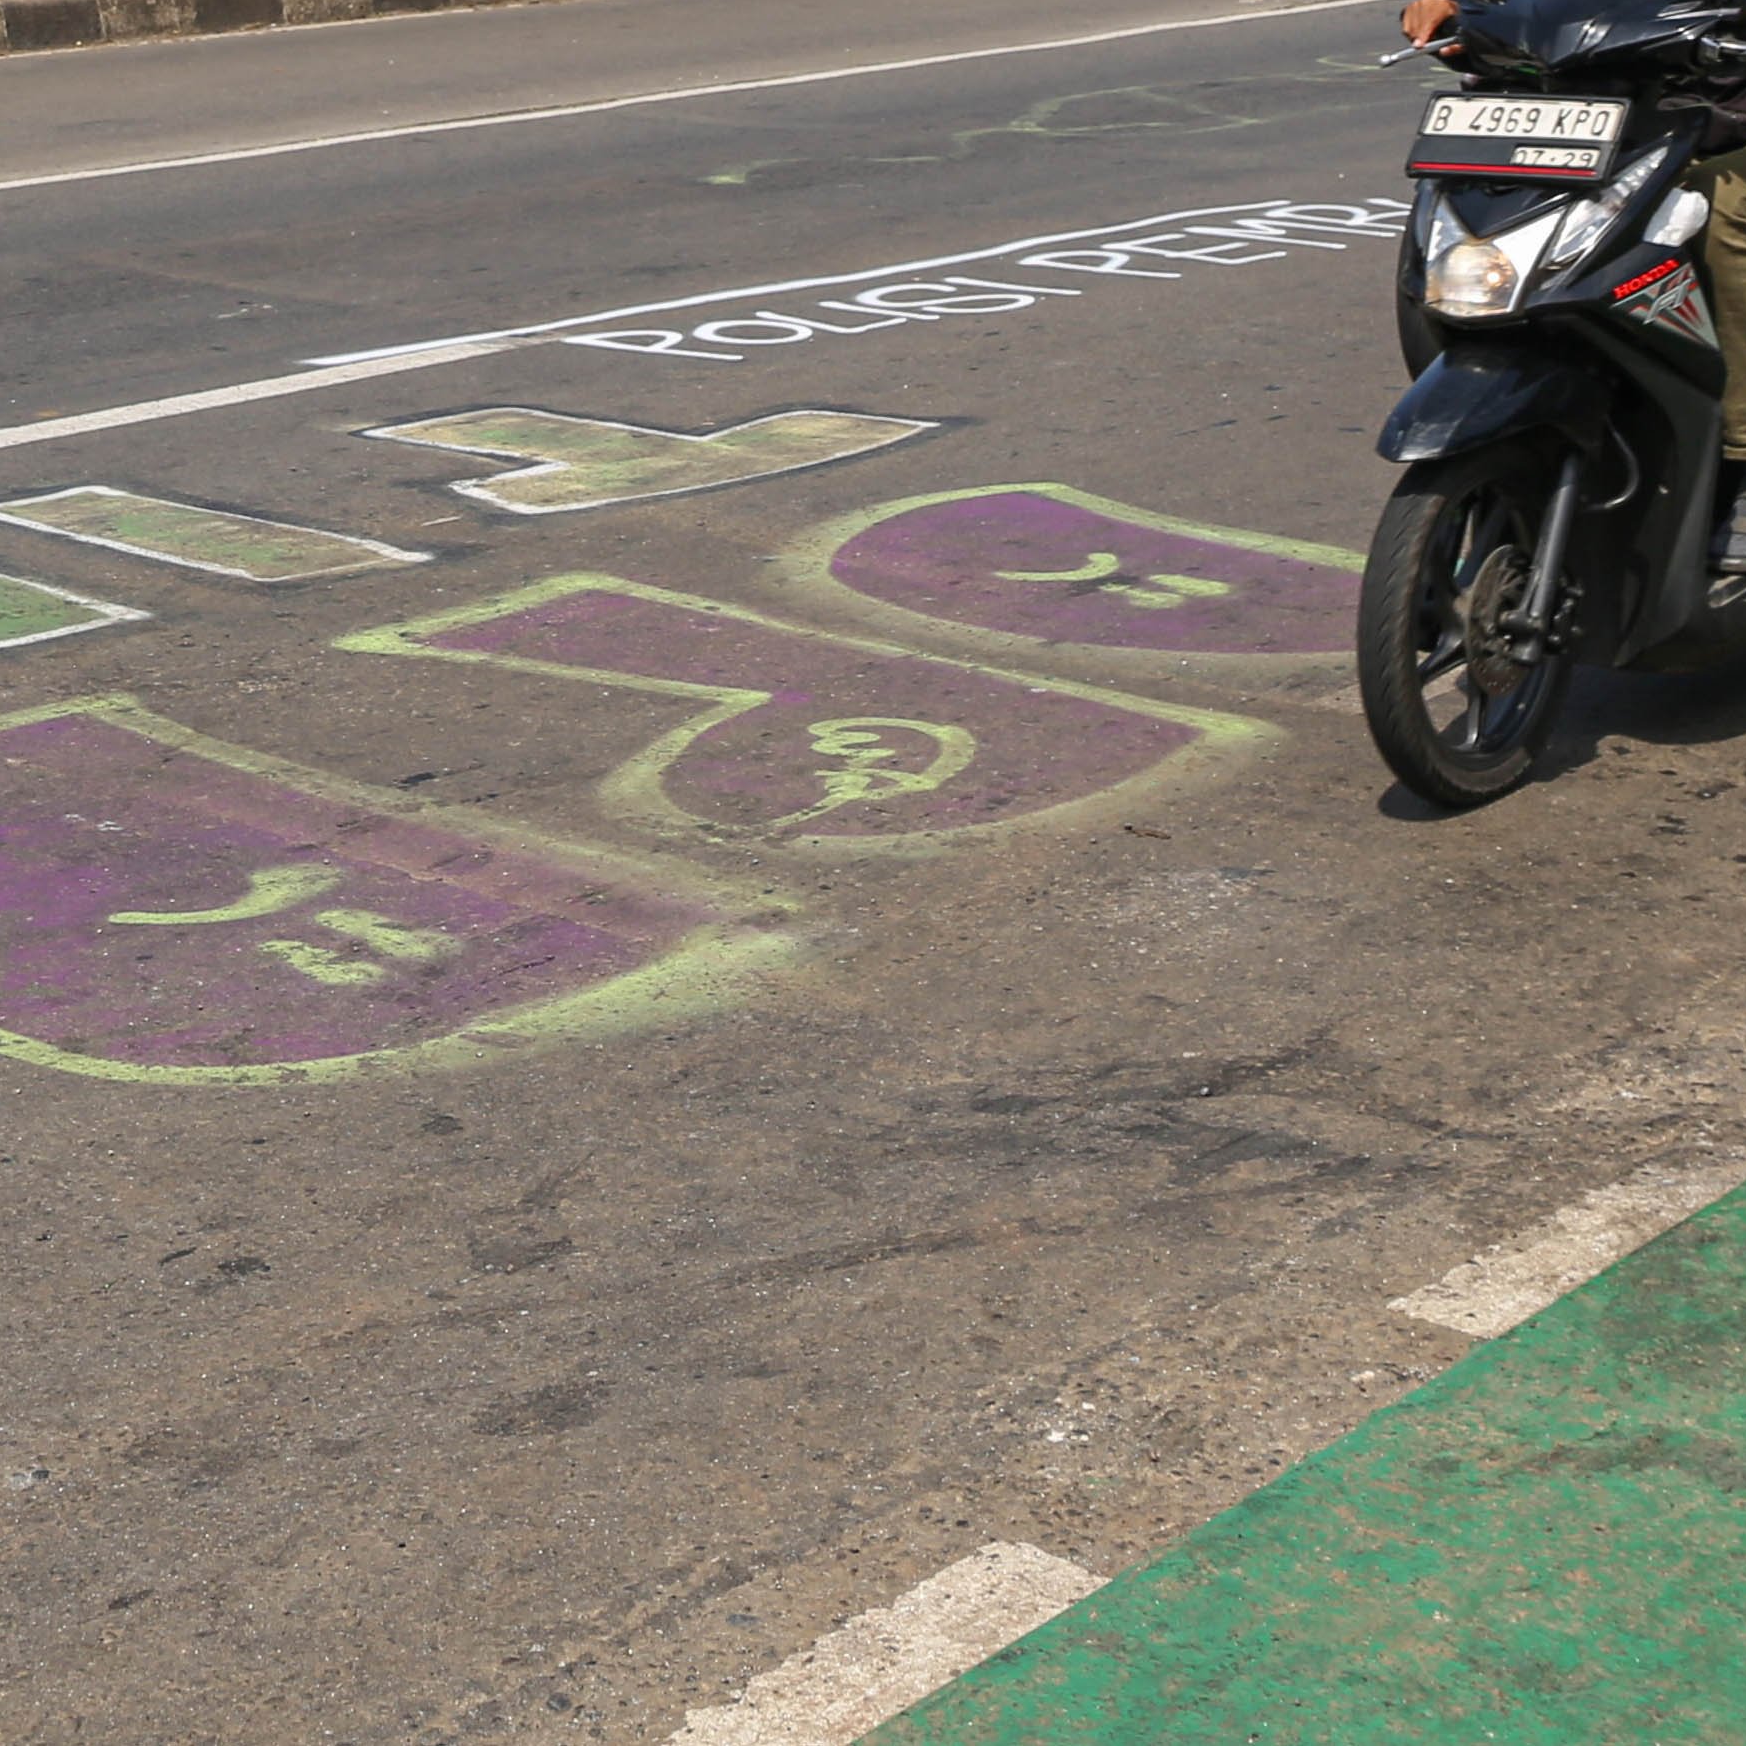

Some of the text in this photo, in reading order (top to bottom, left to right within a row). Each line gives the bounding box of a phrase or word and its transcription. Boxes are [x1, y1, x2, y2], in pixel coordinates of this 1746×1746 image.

[1432, 105, 1453, 132] B
[1468, 106, 1542, 134] 4969
[1612, 258, 1681, 300] HONDA
[562, 275, 1082, 361] POLISI
